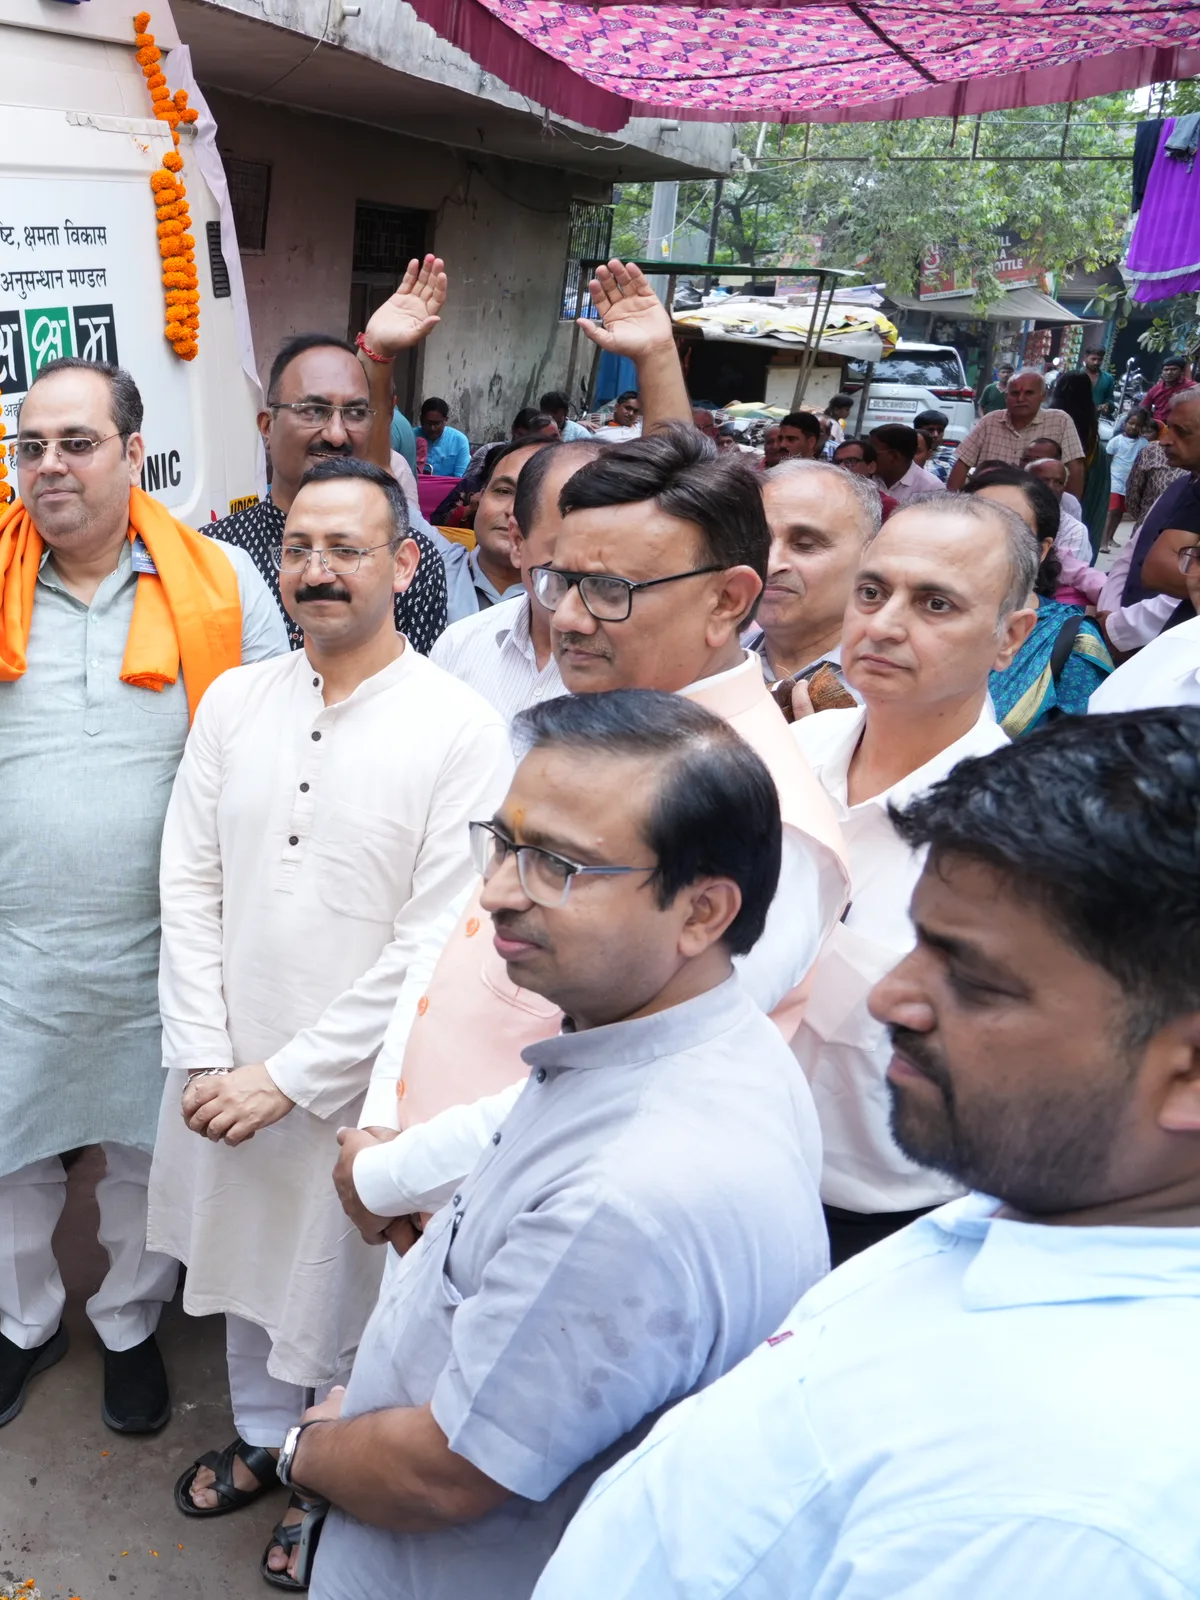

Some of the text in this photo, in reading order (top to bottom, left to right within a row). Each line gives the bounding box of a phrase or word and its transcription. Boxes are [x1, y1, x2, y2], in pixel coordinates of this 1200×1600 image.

[24, 225, 60, 251] क्षमता
[64, 218, 108, 246] विकास
[0, 269, 64, 300] अनुसन्धान
[67, 268, 107, 288] मण्डल
